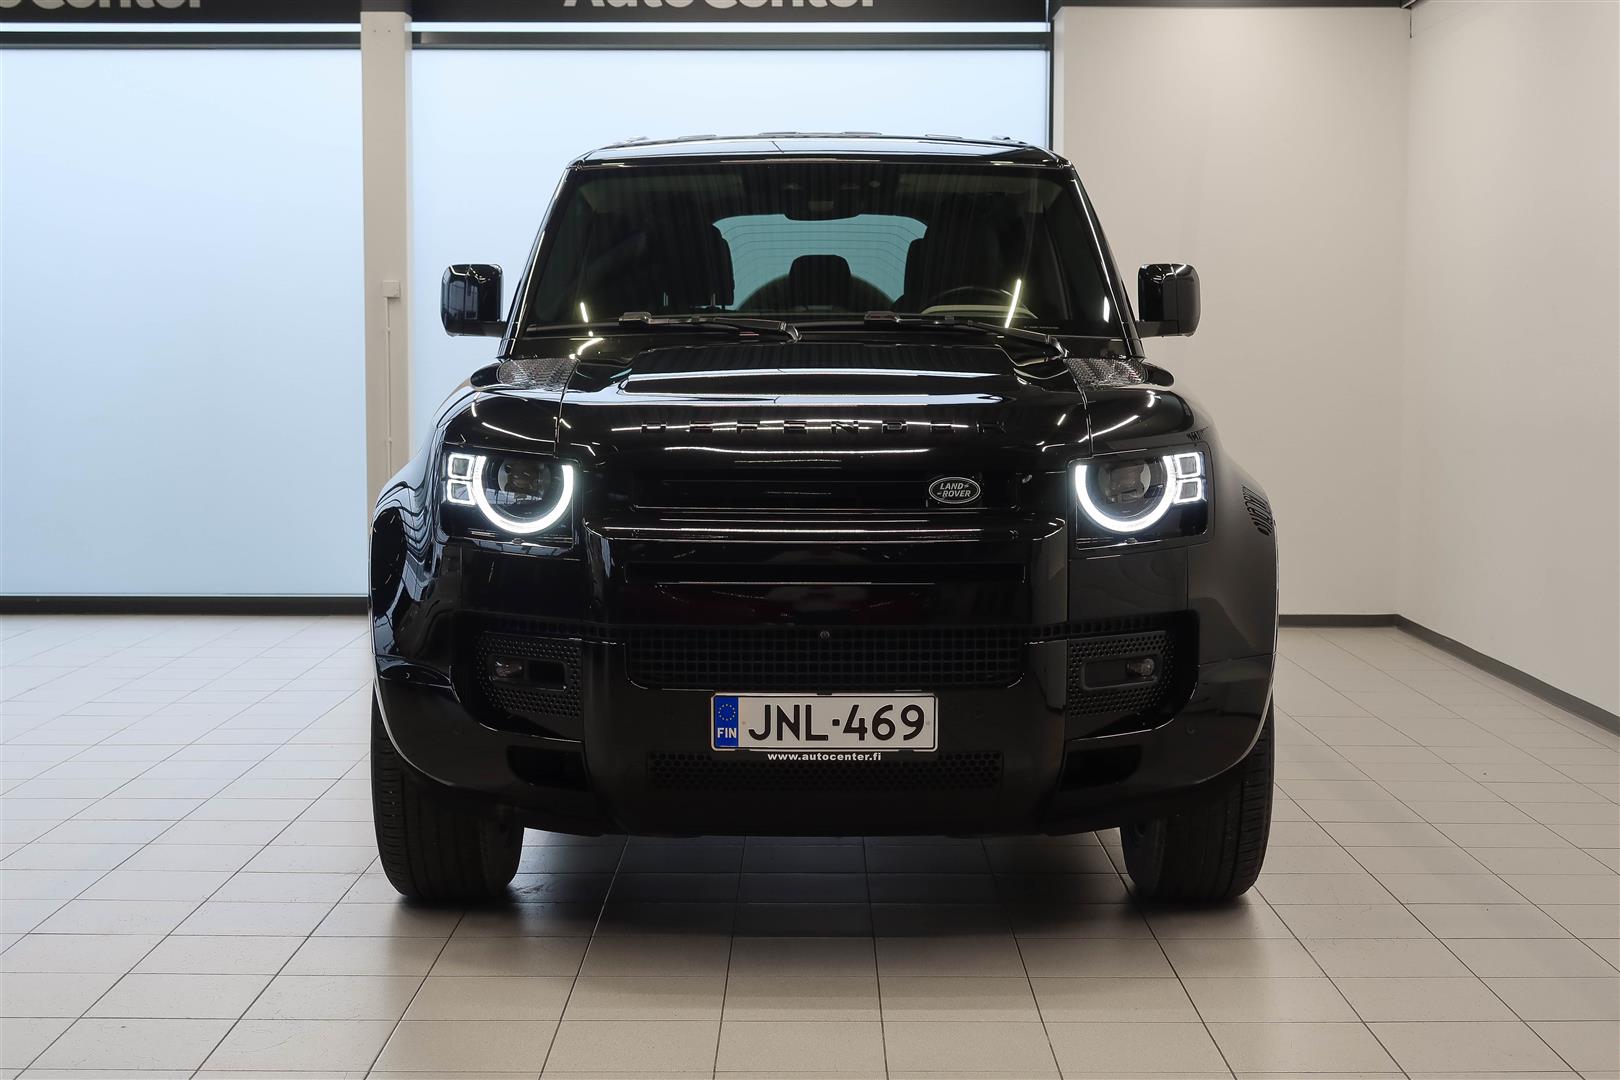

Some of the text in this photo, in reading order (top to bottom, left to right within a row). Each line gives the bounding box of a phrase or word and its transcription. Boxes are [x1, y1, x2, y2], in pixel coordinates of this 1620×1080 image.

[939, 482, 964, 490] LAND
[941, 489, 972, 498] ROVER
[716, 727, 738, 738] FIN
[767, 752, 882, 762] www.autocenter.fi
